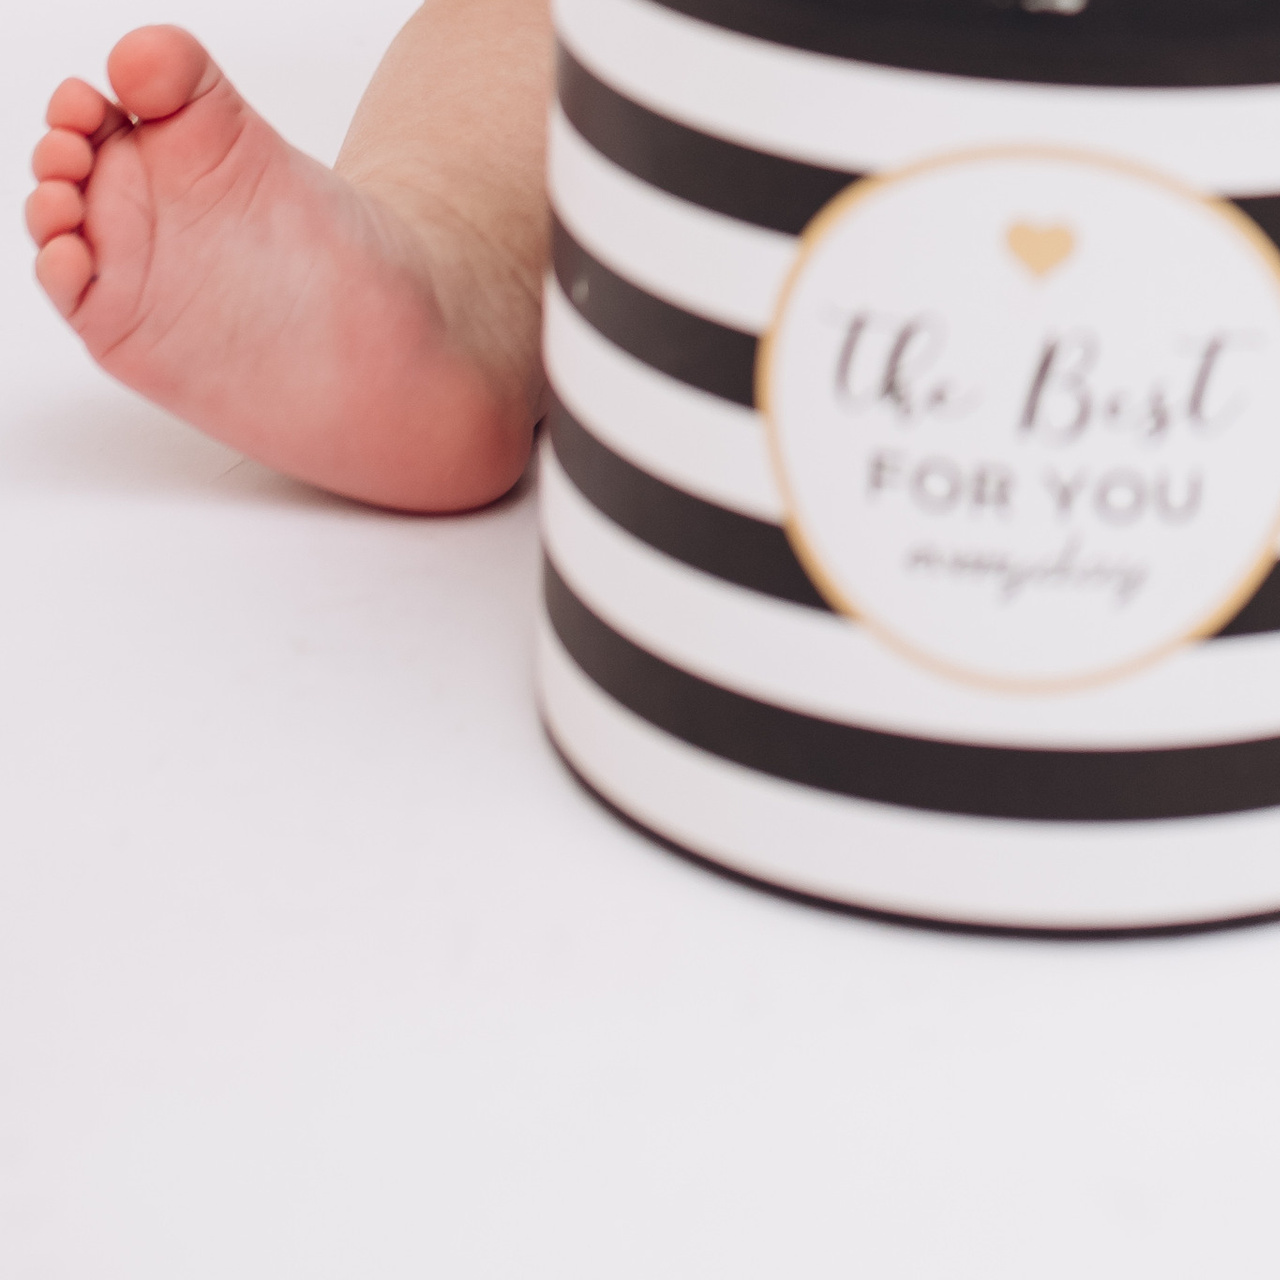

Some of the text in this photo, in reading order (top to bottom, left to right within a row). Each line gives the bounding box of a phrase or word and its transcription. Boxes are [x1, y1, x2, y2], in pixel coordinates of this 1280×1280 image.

[1017, 334, 1264, 445] Best
[868, 447, 1203, 528] FOR YOU
